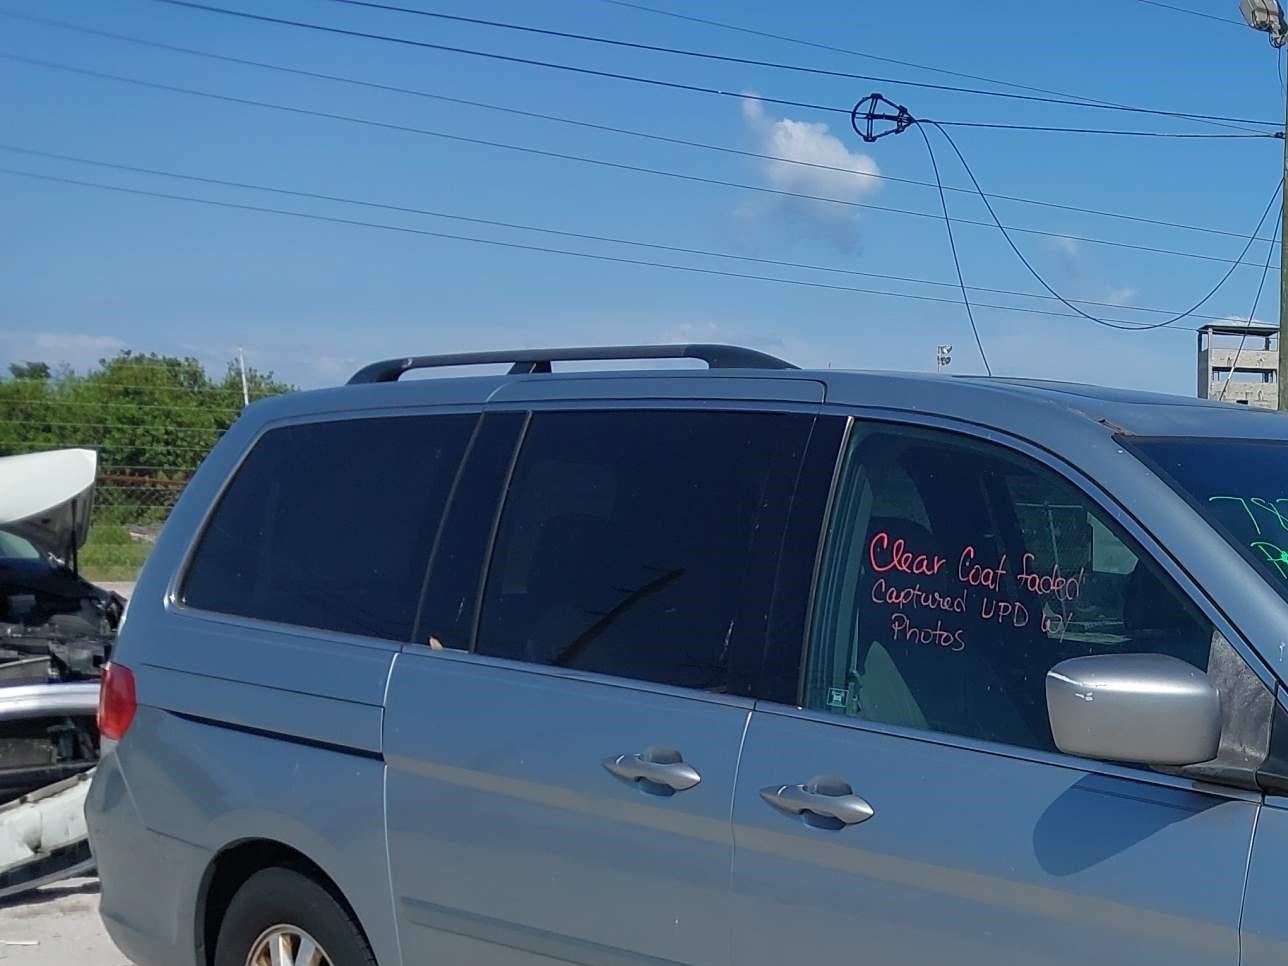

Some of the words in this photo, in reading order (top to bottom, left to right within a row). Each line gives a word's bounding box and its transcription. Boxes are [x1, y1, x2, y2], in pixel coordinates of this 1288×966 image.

[869, 531, 947, 576] Clear
[957, 545, 1006, 592] Coat
[1017, 553, 1085, 601] faded
[871, 578, 967, 613] Captured
[980, 597, 1029, 628] UPD
[890, 612, 966, 652] Photos
